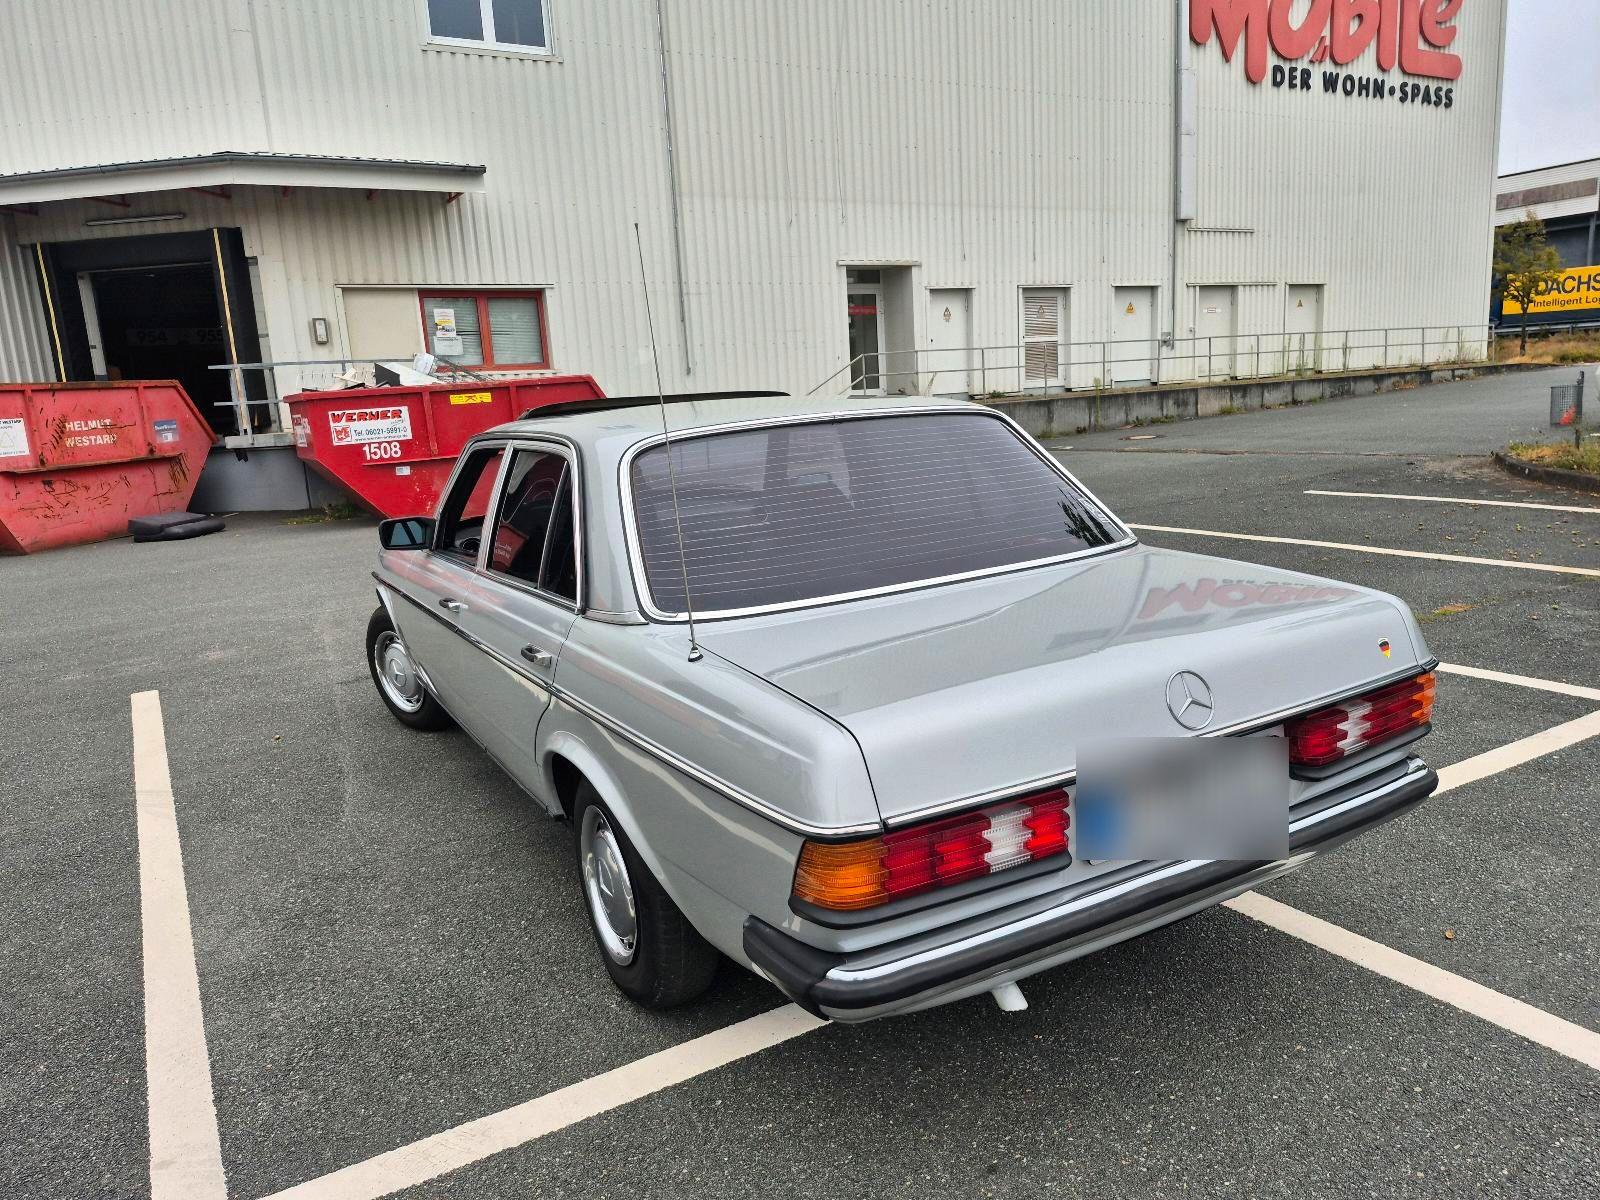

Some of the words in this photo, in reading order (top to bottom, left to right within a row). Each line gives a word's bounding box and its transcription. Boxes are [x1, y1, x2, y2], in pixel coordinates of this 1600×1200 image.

[1272, 64, 1312, 91] DER
[1534, 297, 1582, 307] Intelligent
[330, 409, 403, 424] WERNER
[353, 429, 364, 437] Tel.
[362, 441, 402, 460] 1508
